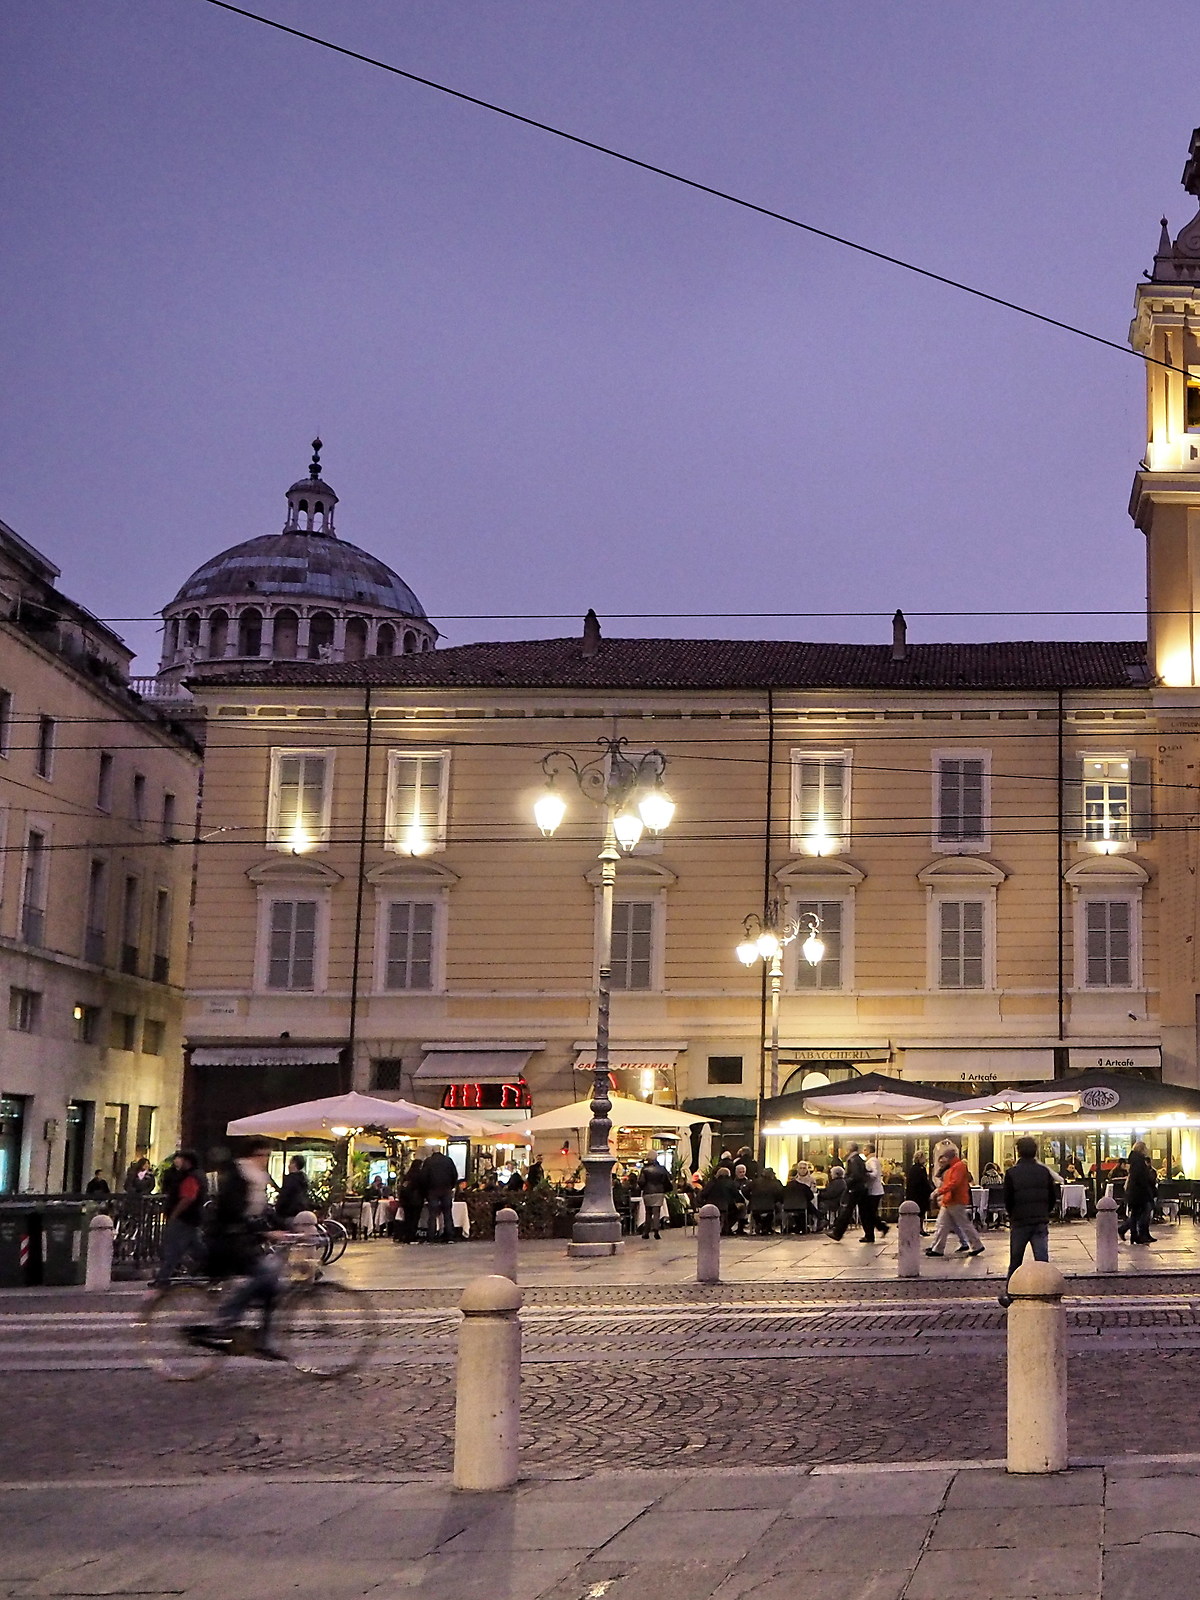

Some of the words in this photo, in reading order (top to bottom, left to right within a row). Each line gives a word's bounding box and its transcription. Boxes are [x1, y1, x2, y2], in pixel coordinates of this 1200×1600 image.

[792, 1051, 871, 1060] TABACCHERIA
[1105, 1058, 1134, 1066] Artcafé
[968, 1072, 998, 1081] Artcafé
